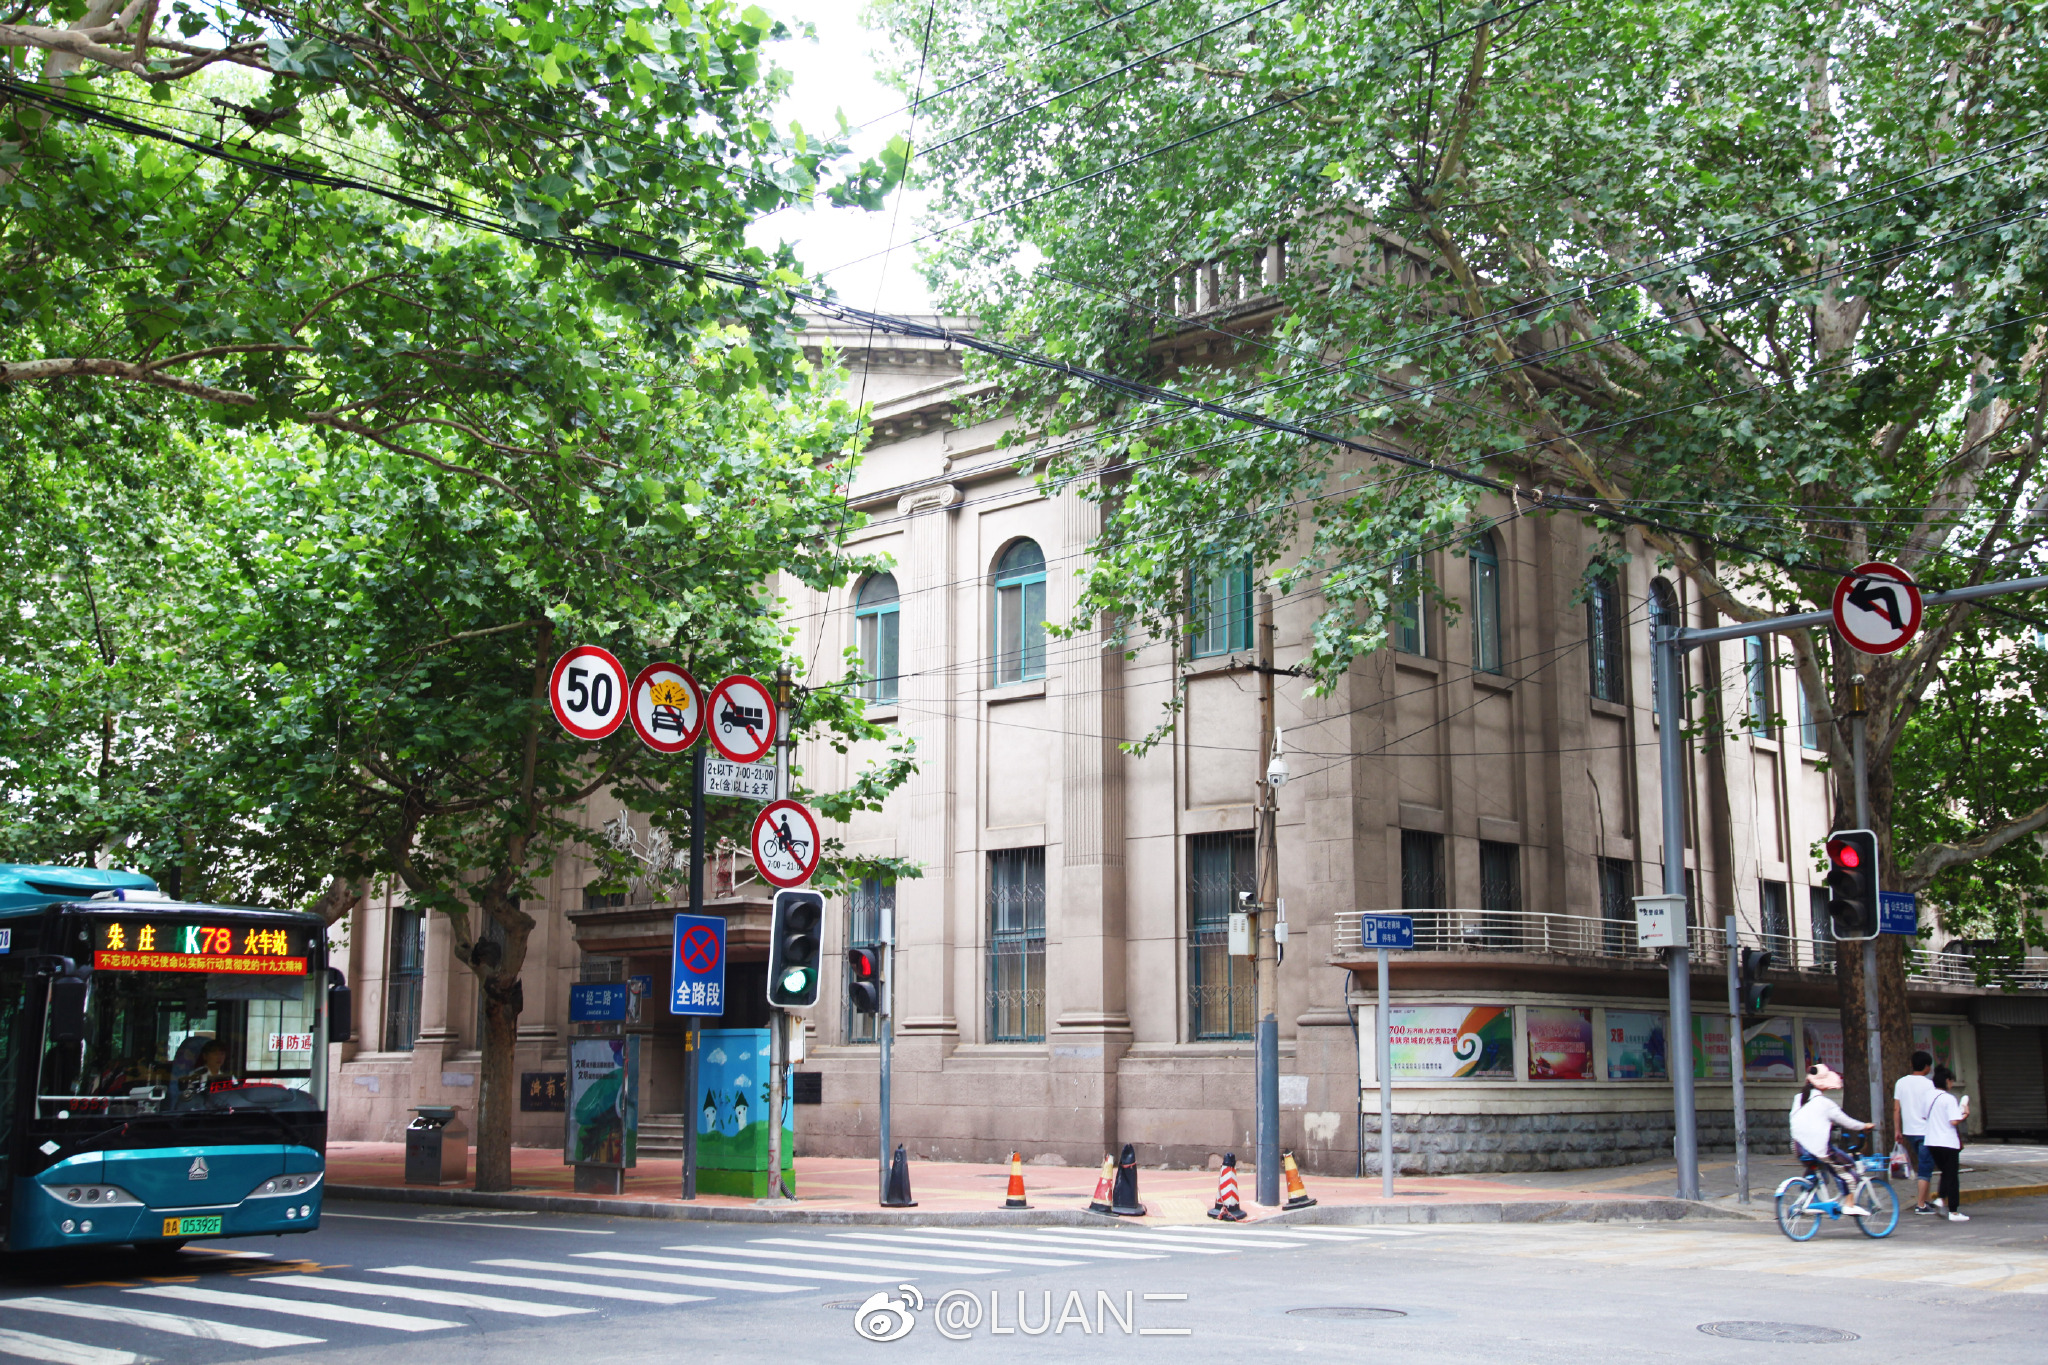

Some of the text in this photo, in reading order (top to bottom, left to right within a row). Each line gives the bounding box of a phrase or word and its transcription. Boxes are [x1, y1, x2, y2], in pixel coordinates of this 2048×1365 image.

[567, 667, 612, 716] 50
[707, 763, 774, 781] 2t以下 7:00-21:00
[710, 778, 769, 795] 2t(含)以上 全天
[107, 923, 288, 956] 朱庄 K78 火车站
[1366, 920, 1375, 941] P
[1382, 933, 1397, 943] 停车场
[100, 953, 303, 973] 不忘初心牢记使命以实际行动贯彻党的十九大精神
[586, 990, 612, 1006] 经二路
[676, 980, 720, 1006] 全路段
[1389, 1025, 1406, 1034] 700
